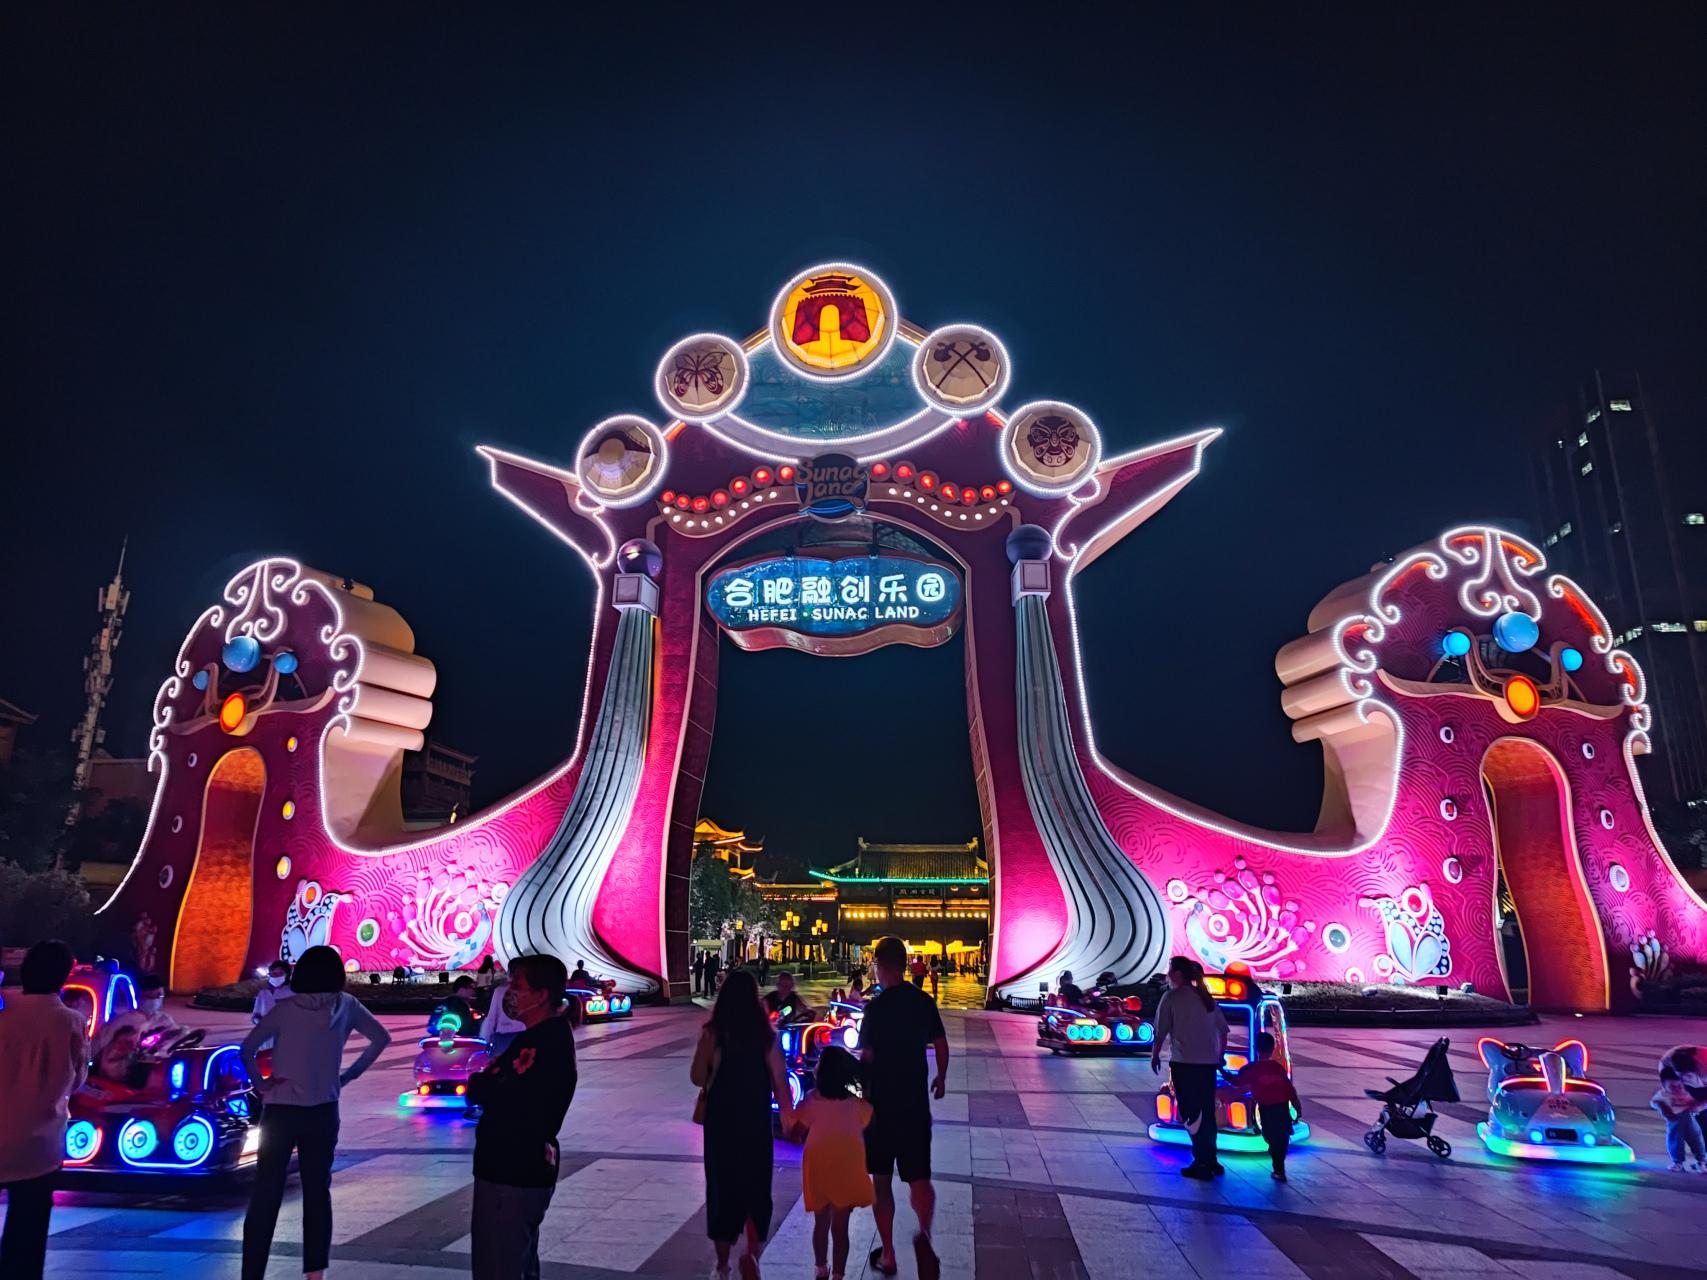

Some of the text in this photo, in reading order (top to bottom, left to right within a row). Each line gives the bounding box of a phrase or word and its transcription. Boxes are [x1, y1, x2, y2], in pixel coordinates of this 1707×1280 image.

[793, 457, 869, 484] Sunac
[724, 573, 946, 606] 合肥融创乐园
[748, 606, 919, 621] HEFEI SUNAC LAND
